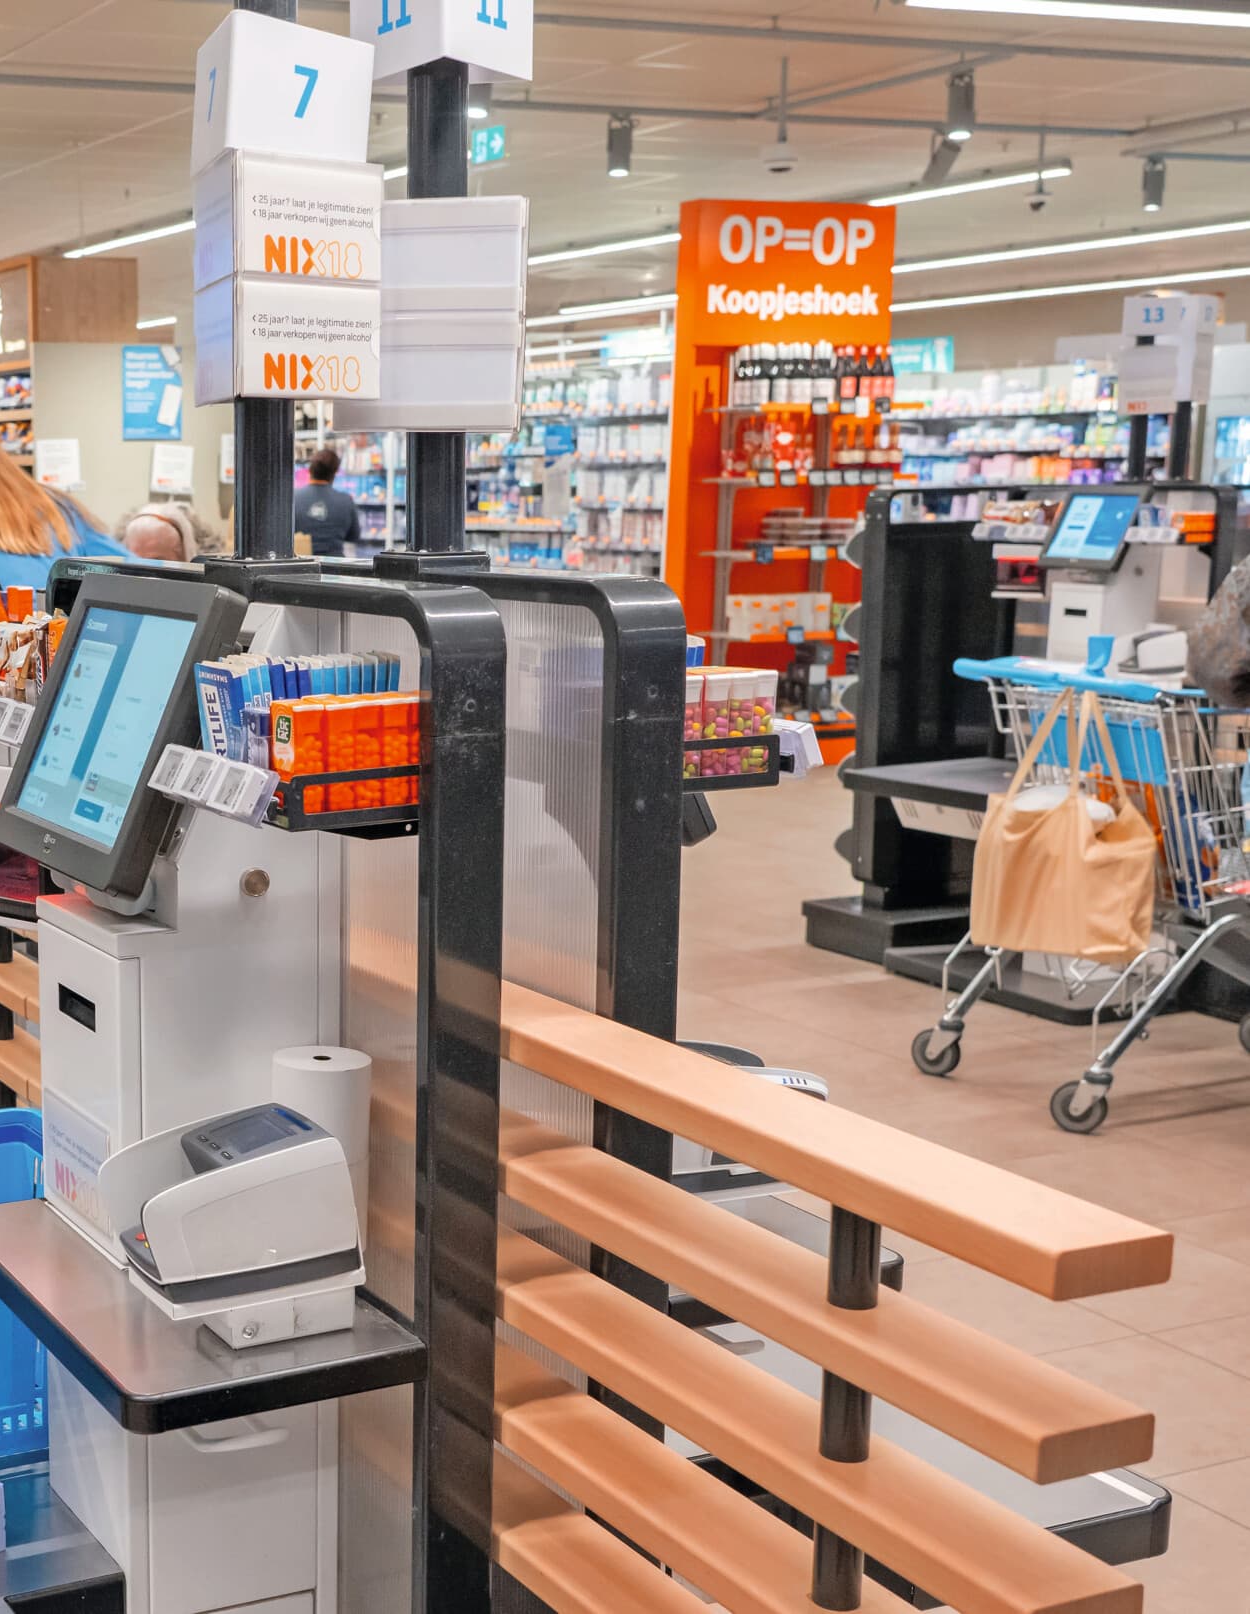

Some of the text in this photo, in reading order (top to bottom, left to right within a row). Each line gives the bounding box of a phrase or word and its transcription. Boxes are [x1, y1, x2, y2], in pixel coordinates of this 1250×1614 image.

[294, 64, 319, 119] 7
[258, 208, 267, 218] 18
[268, 210, 283, 221] jaar
[283, 212, 318, 223] verkopen
[318, 216, 330, 227] wij
[330, 218, 347, 228] geen
[292, 198, 306, 208] laat
[308, 200, 316, 211] je
[317, 200, 355, 213] legitimatie
[719, 214, 876, 266] OP=OP
[264, 234, 362, 279] NIX18
[707, 283, 879, 321] Koopjeshoek
[1142, 307, 1165, 324] 13
[258, 313, 268, 323] 25
[269, 315, 289, 325] jaar?
[291, 316, 306, 325] laat
[307, 317, 315, 327] je
[316, 317, 354, 328] legitimatie
[355, 319, 372, 329] zien!
[258, 327, 267, 337] 18
[267, 329, 282, 339] jaar
[283, 330, 317, 341] verkopen
[318, 332, 328, 343] wij
[328, 333, 346, 343] geen
[264, 352, 361, 392] NIX18
